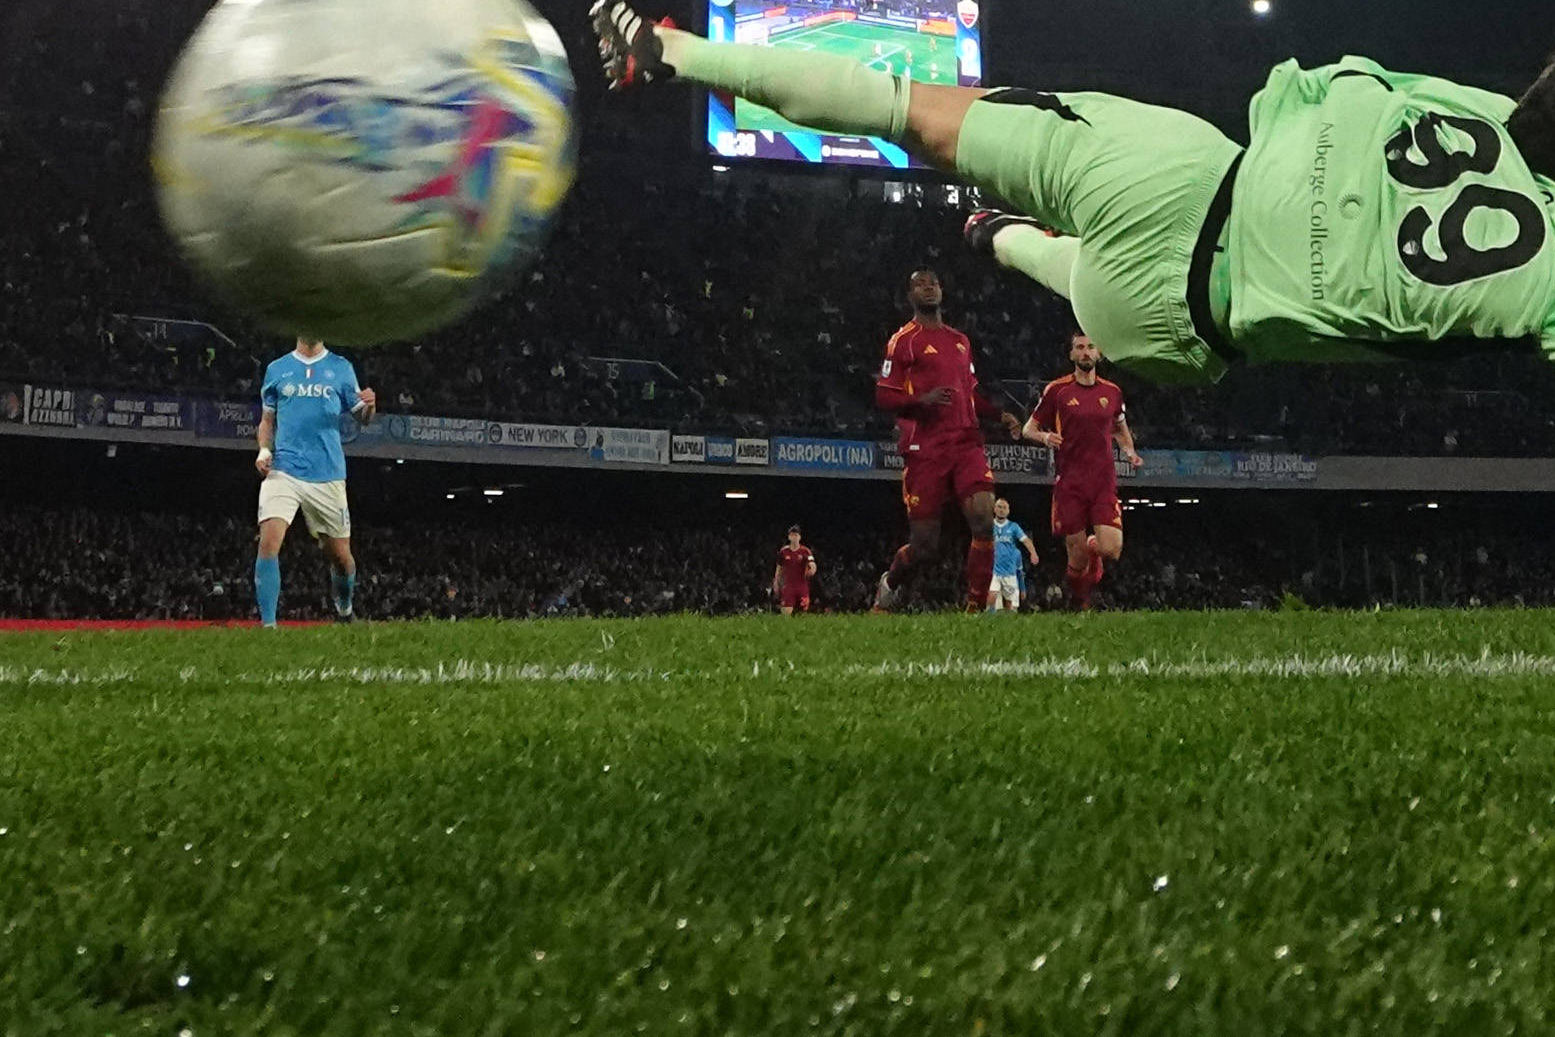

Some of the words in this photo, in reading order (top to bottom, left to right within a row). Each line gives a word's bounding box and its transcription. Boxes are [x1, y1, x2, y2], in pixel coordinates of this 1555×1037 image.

[1308, 121, 1335, 193] Auberge
[1384, 111, 1546, 287] 99
[1309, 194, 1330, 301] Collection
[297, 383, 334, 399] MSC
[507, 426, 535, 443] NEW
[537, 427, 568, 444] YORK
[673, 441, 704, 455] NAPOLI
[777, 442, 843, 464] AGROPOLI
